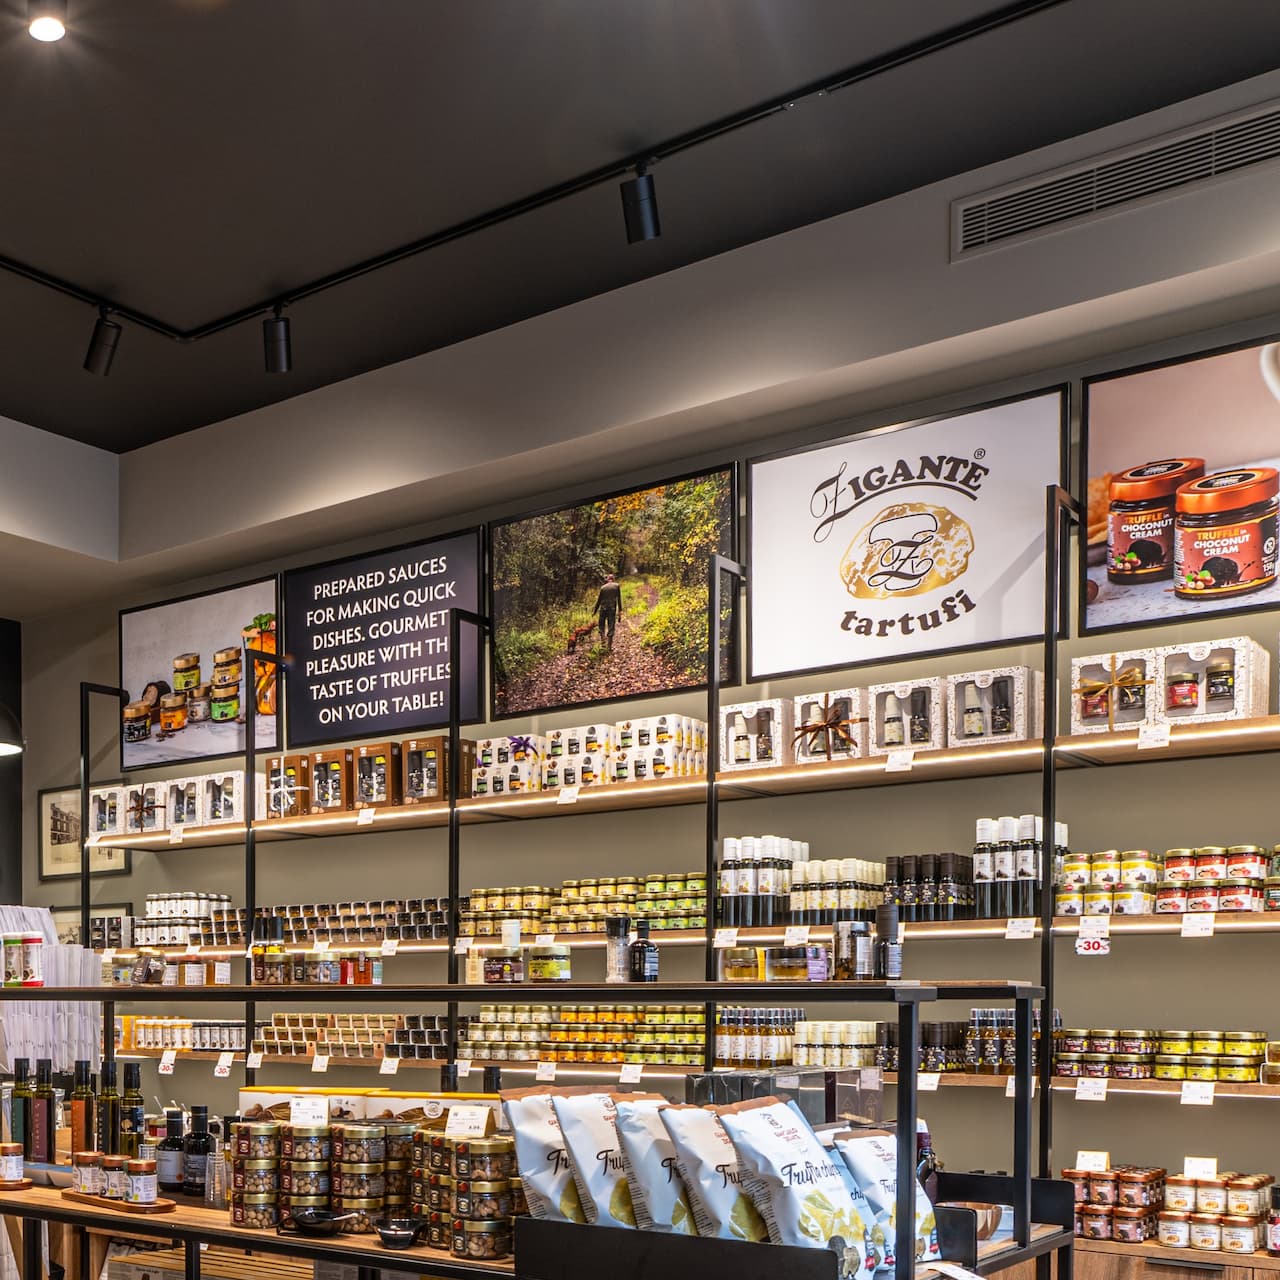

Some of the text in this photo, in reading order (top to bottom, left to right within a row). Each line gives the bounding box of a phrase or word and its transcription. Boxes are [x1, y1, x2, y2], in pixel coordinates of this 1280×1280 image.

[1121, 517, 1174, 532] CHOCONUT
[1125, 511, 1163, 525] TRUFFLE
[1130, 529, 1162, 540] CREAM
[1197, 528, 1240, 541] TRUFFLE
[1194, 534, 1251, 549] CHOCONUT
[1203, 546, 1239, 557] CREAM
[314, 556, 447, 600] PREPARED SAUCES
[306, 581, 456, 627] FOR MAKING QUICK
[840, 589, 977, 638] tartufi
[313, 609, 449, 650] DISHES. GOURMET
[306, 636, 449, 677] PLEASURE WITH TH
[310, 662, 451, 700] TASTE OF TRUFFLES
[319, 690, 445, 724] ON YOUR TABLE!
